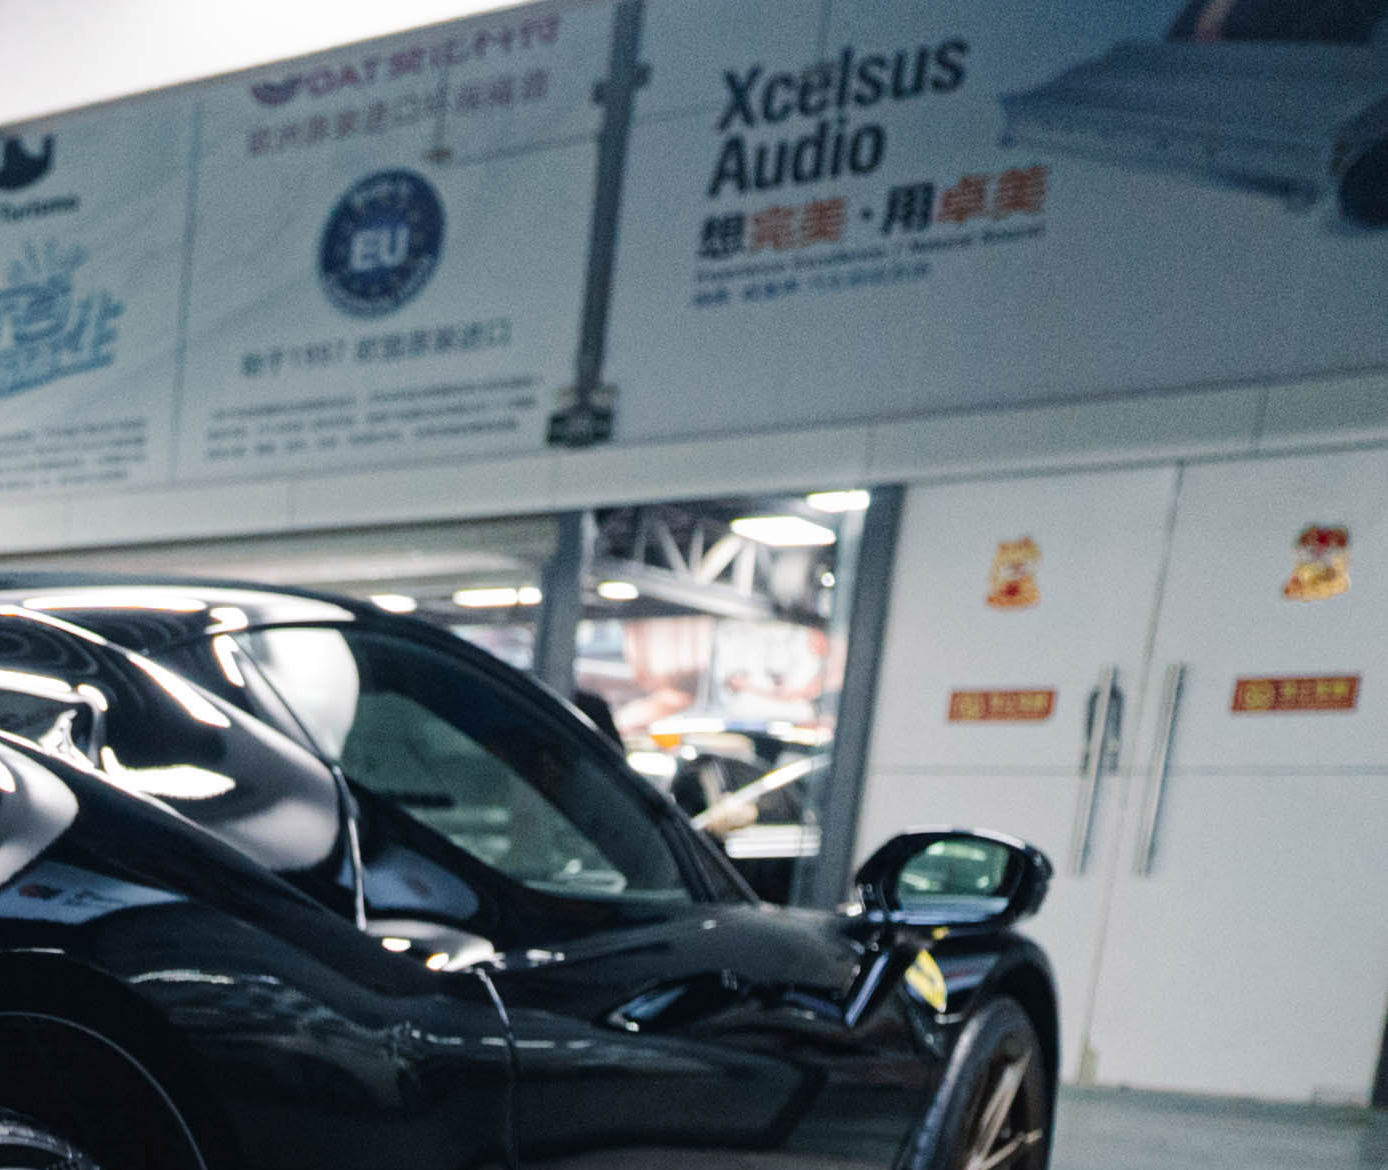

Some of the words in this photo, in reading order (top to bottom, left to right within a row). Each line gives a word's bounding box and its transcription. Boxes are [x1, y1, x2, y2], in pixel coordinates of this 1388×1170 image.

[717, 35, 970, 131] Xcelsus
[707, 116, 887, 198] Audio
[349, 218, 409, 273] EU
